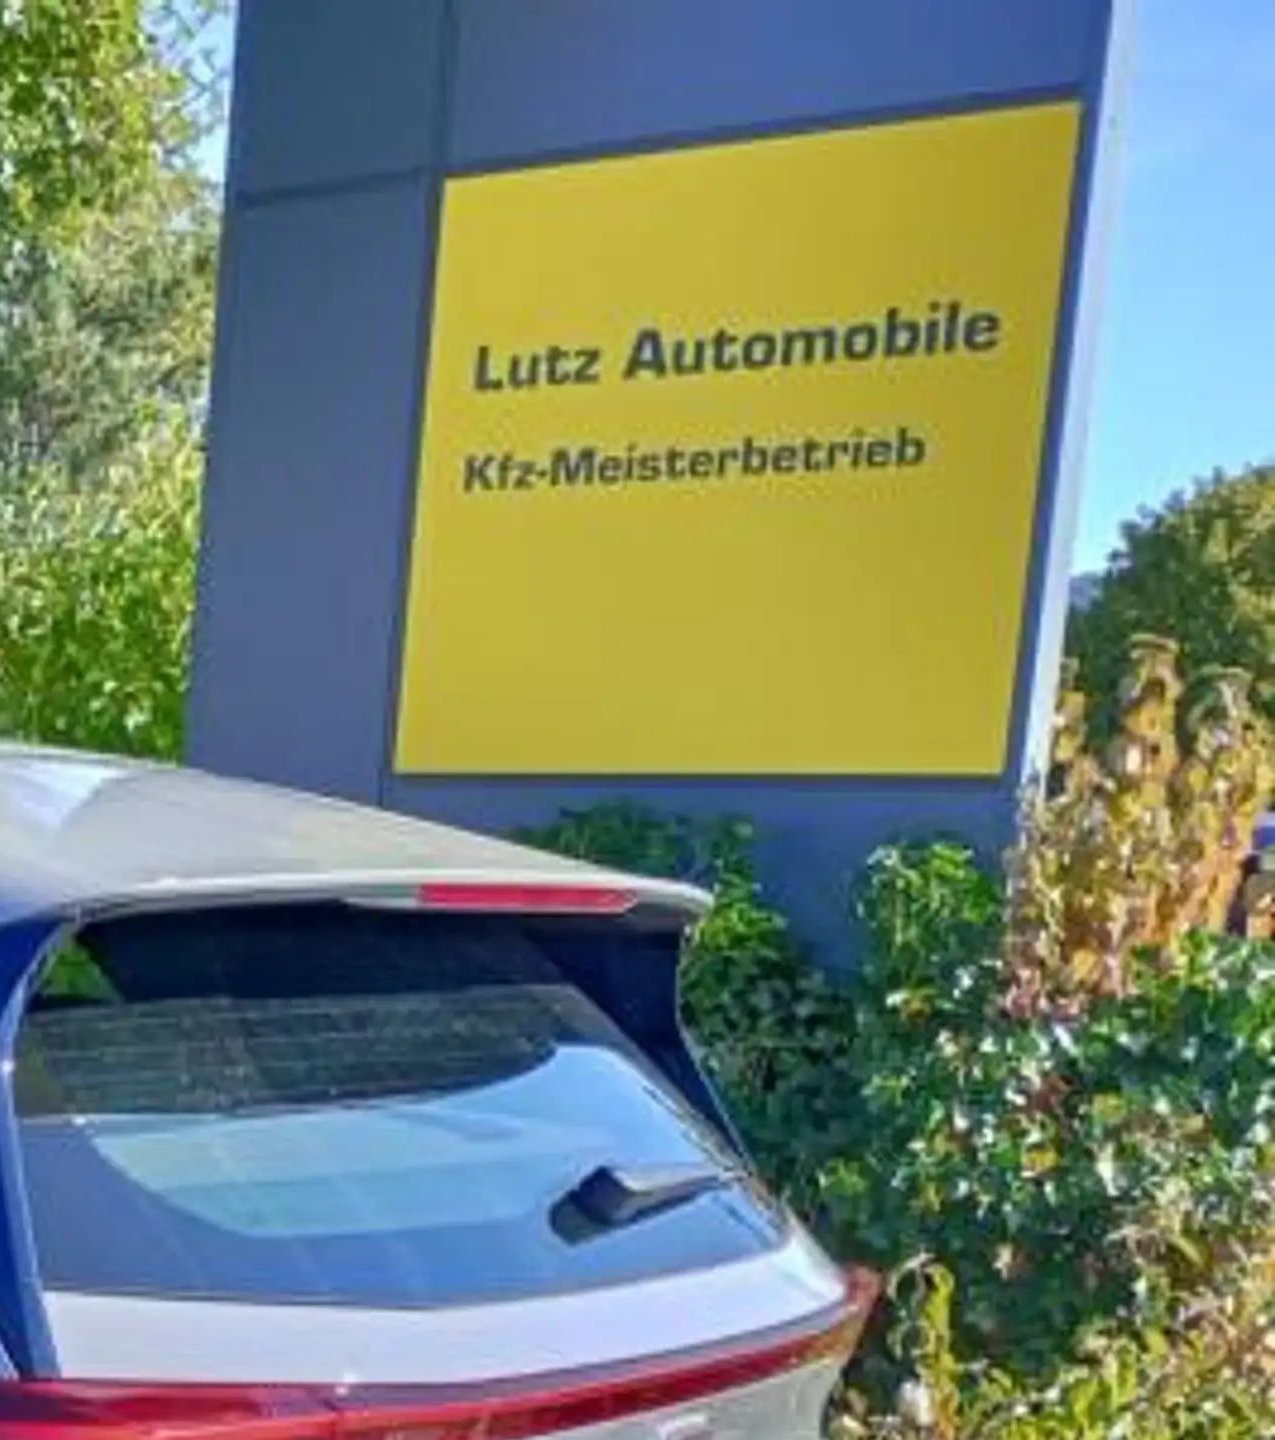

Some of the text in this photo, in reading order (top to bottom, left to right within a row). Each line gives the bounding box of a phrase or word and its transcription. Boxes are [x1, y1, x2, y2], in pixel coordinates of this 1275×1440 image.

[473, 300, 1001, 392] Lutz Automobile
[462, 427, 927, 492] Kfz-Meisterbetrieb
